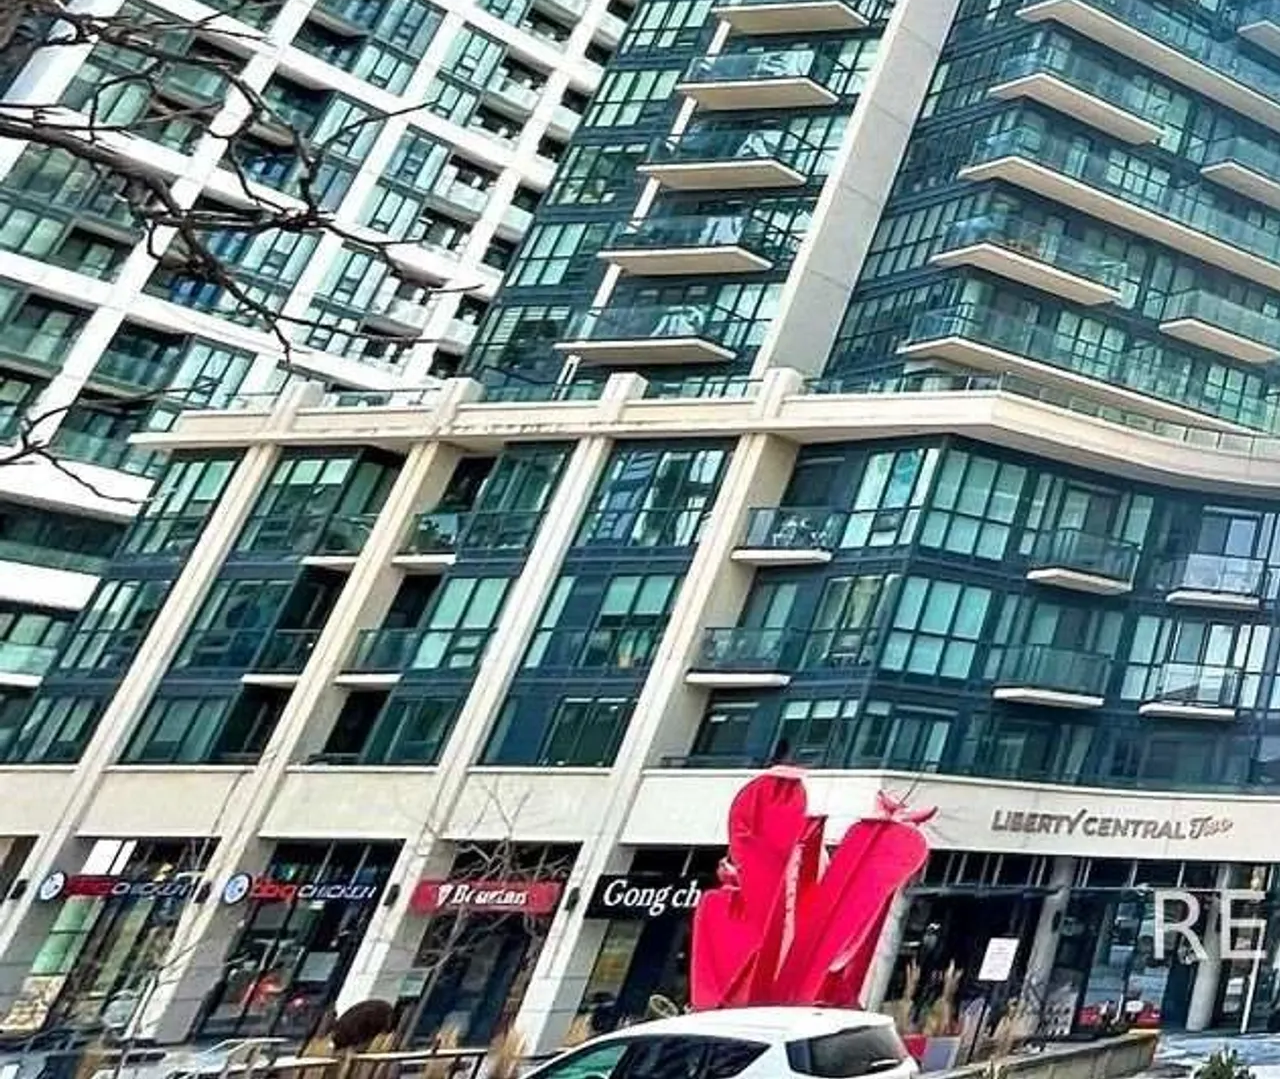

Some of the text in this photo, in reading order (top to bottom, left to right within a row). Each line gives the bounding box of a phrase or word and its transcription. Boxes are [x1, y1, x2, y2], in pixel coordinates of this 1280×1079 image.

[991, 808, 1087, 834] LIBERTY
[1082, 815, 1186, 839] CENTRAL
[603, 879, 666, 916] Gong
